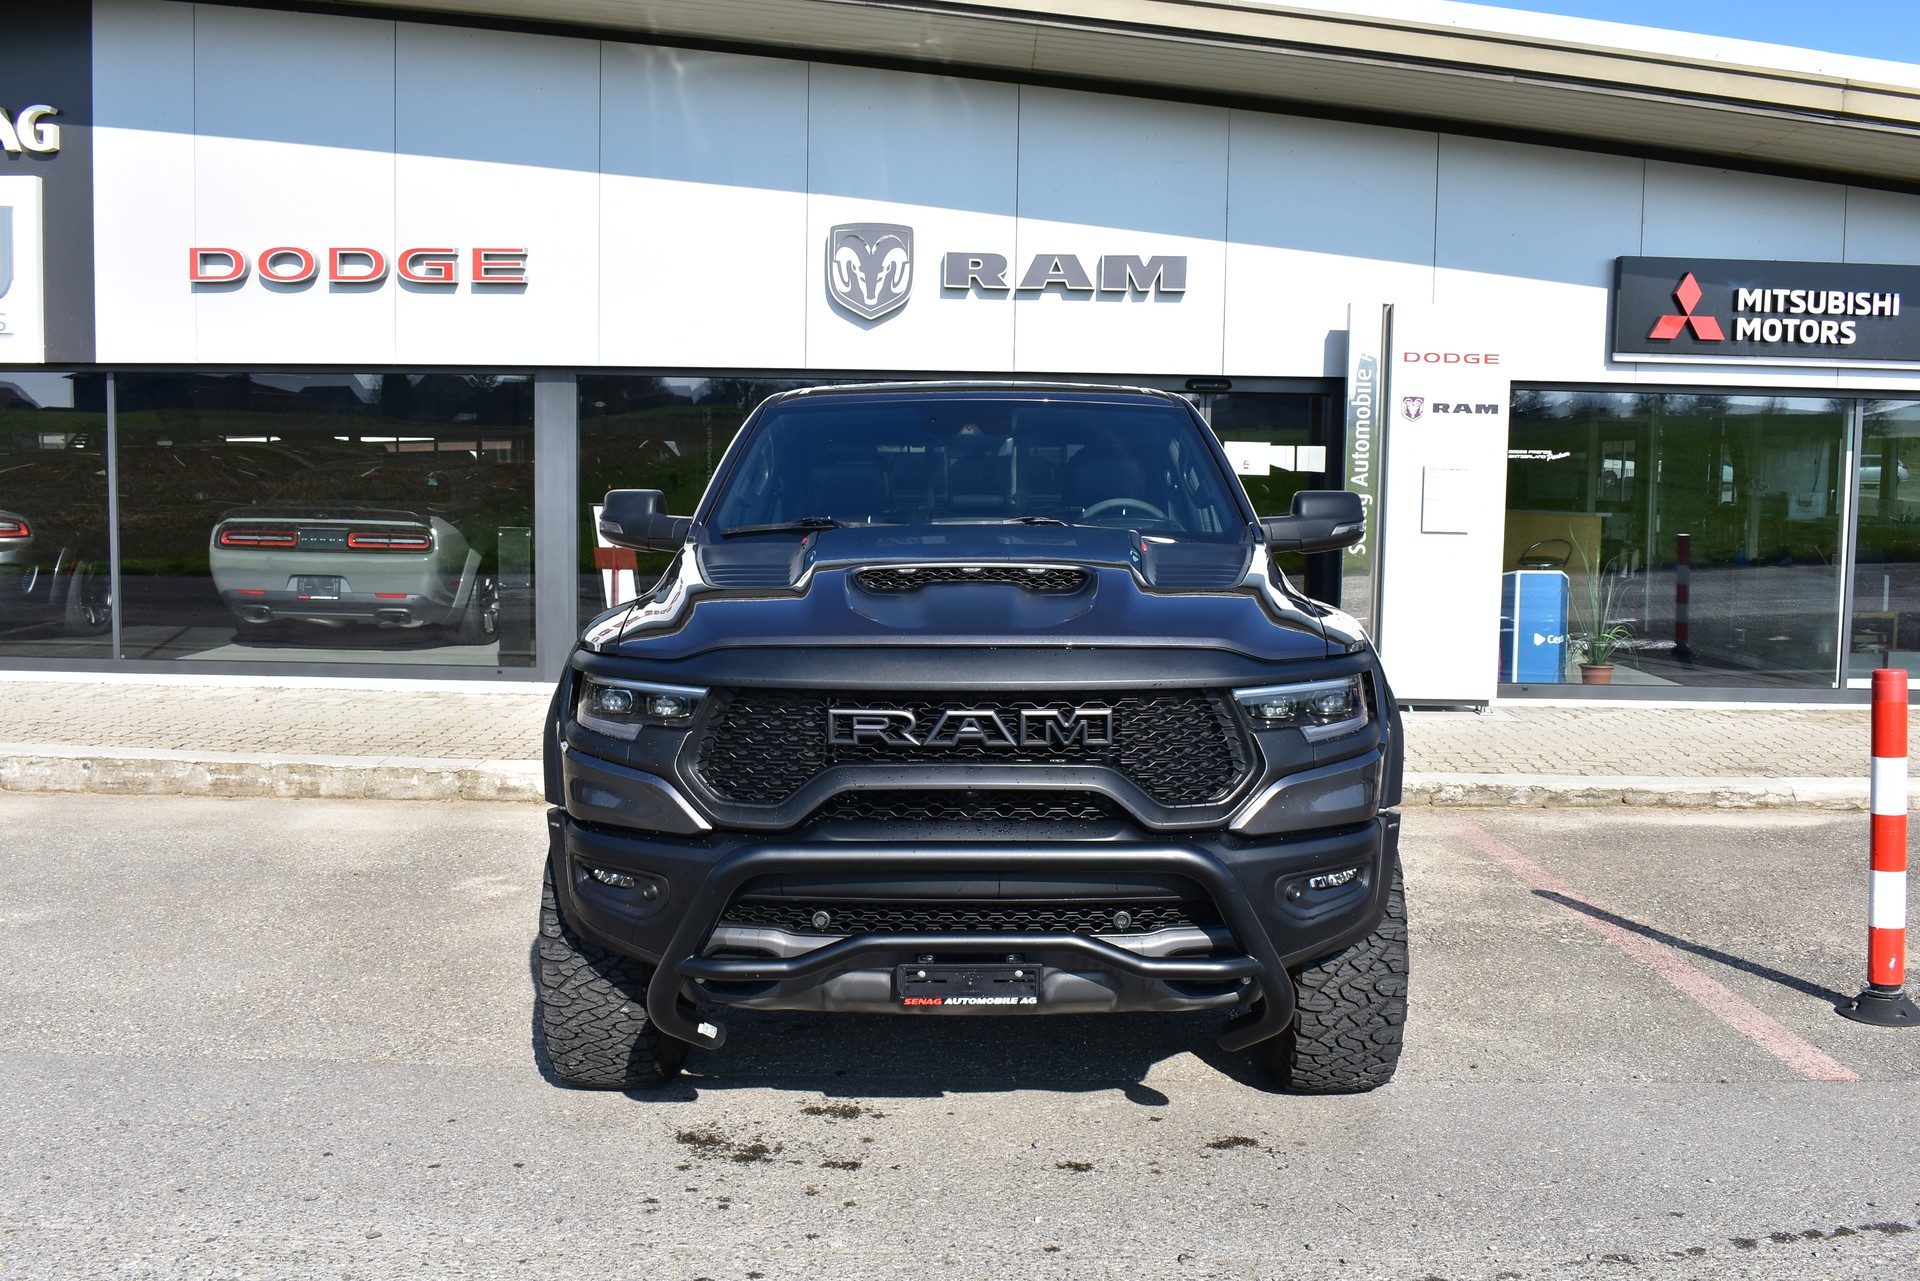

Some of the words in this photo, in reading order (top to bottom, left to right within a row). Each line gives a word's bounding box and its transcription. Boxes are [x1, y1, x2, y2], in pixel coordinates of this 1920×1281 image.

[189, 247, 529, 284] DODGE
[942, 252, 1188, 292] RAM
[1737, 288, 1900, 316] MITSUBISHI
[1736, 317, 1857, 345] MOTORS
[1403, 352, 1500, 365] DODGE
[1432, 402, 1499, 415] RAM
[1350, 368, 1372, 487] Automobile
[828, 709, 1113, 746] RAM
[944, 997, 1018, 1005] AUTOMOBILE
